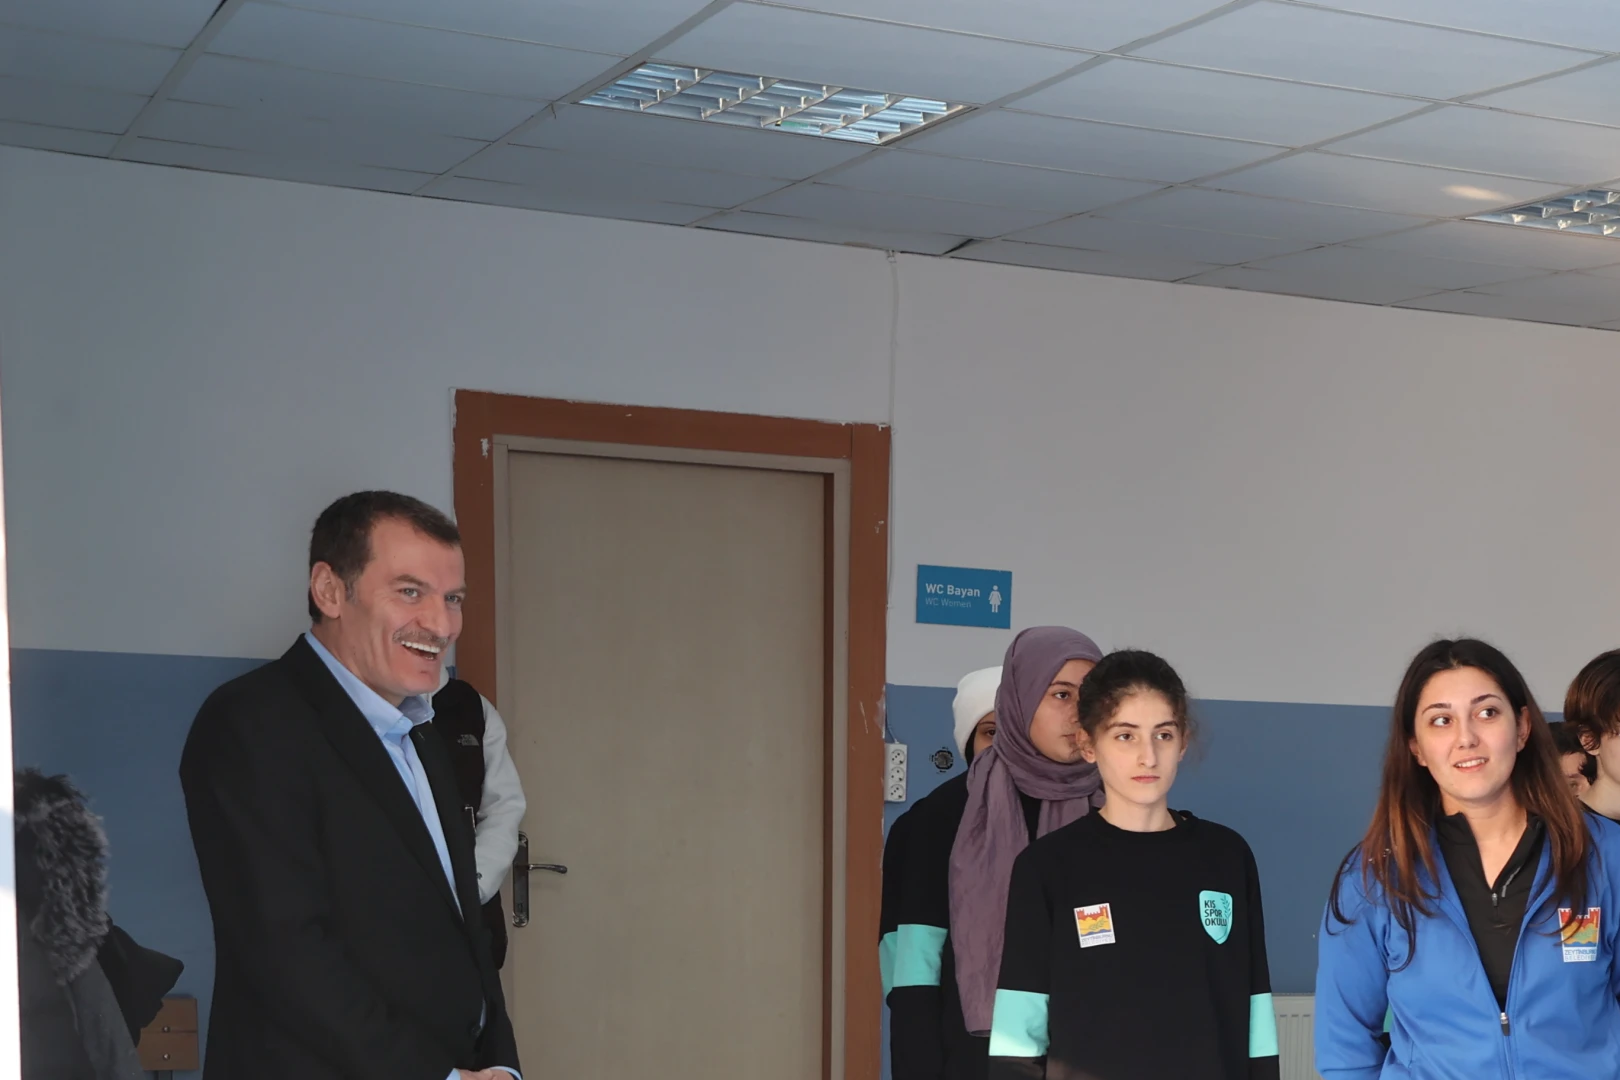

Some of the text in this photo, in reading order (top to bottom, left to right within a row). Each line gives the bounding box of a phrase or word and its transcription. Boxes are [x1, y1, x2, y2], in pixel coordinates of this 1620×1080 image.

[925, 583, 980, 598] WC Bayan
[925, 597, 972, 608] WC Women
[1204, 909, 1222, 918] SPOR
